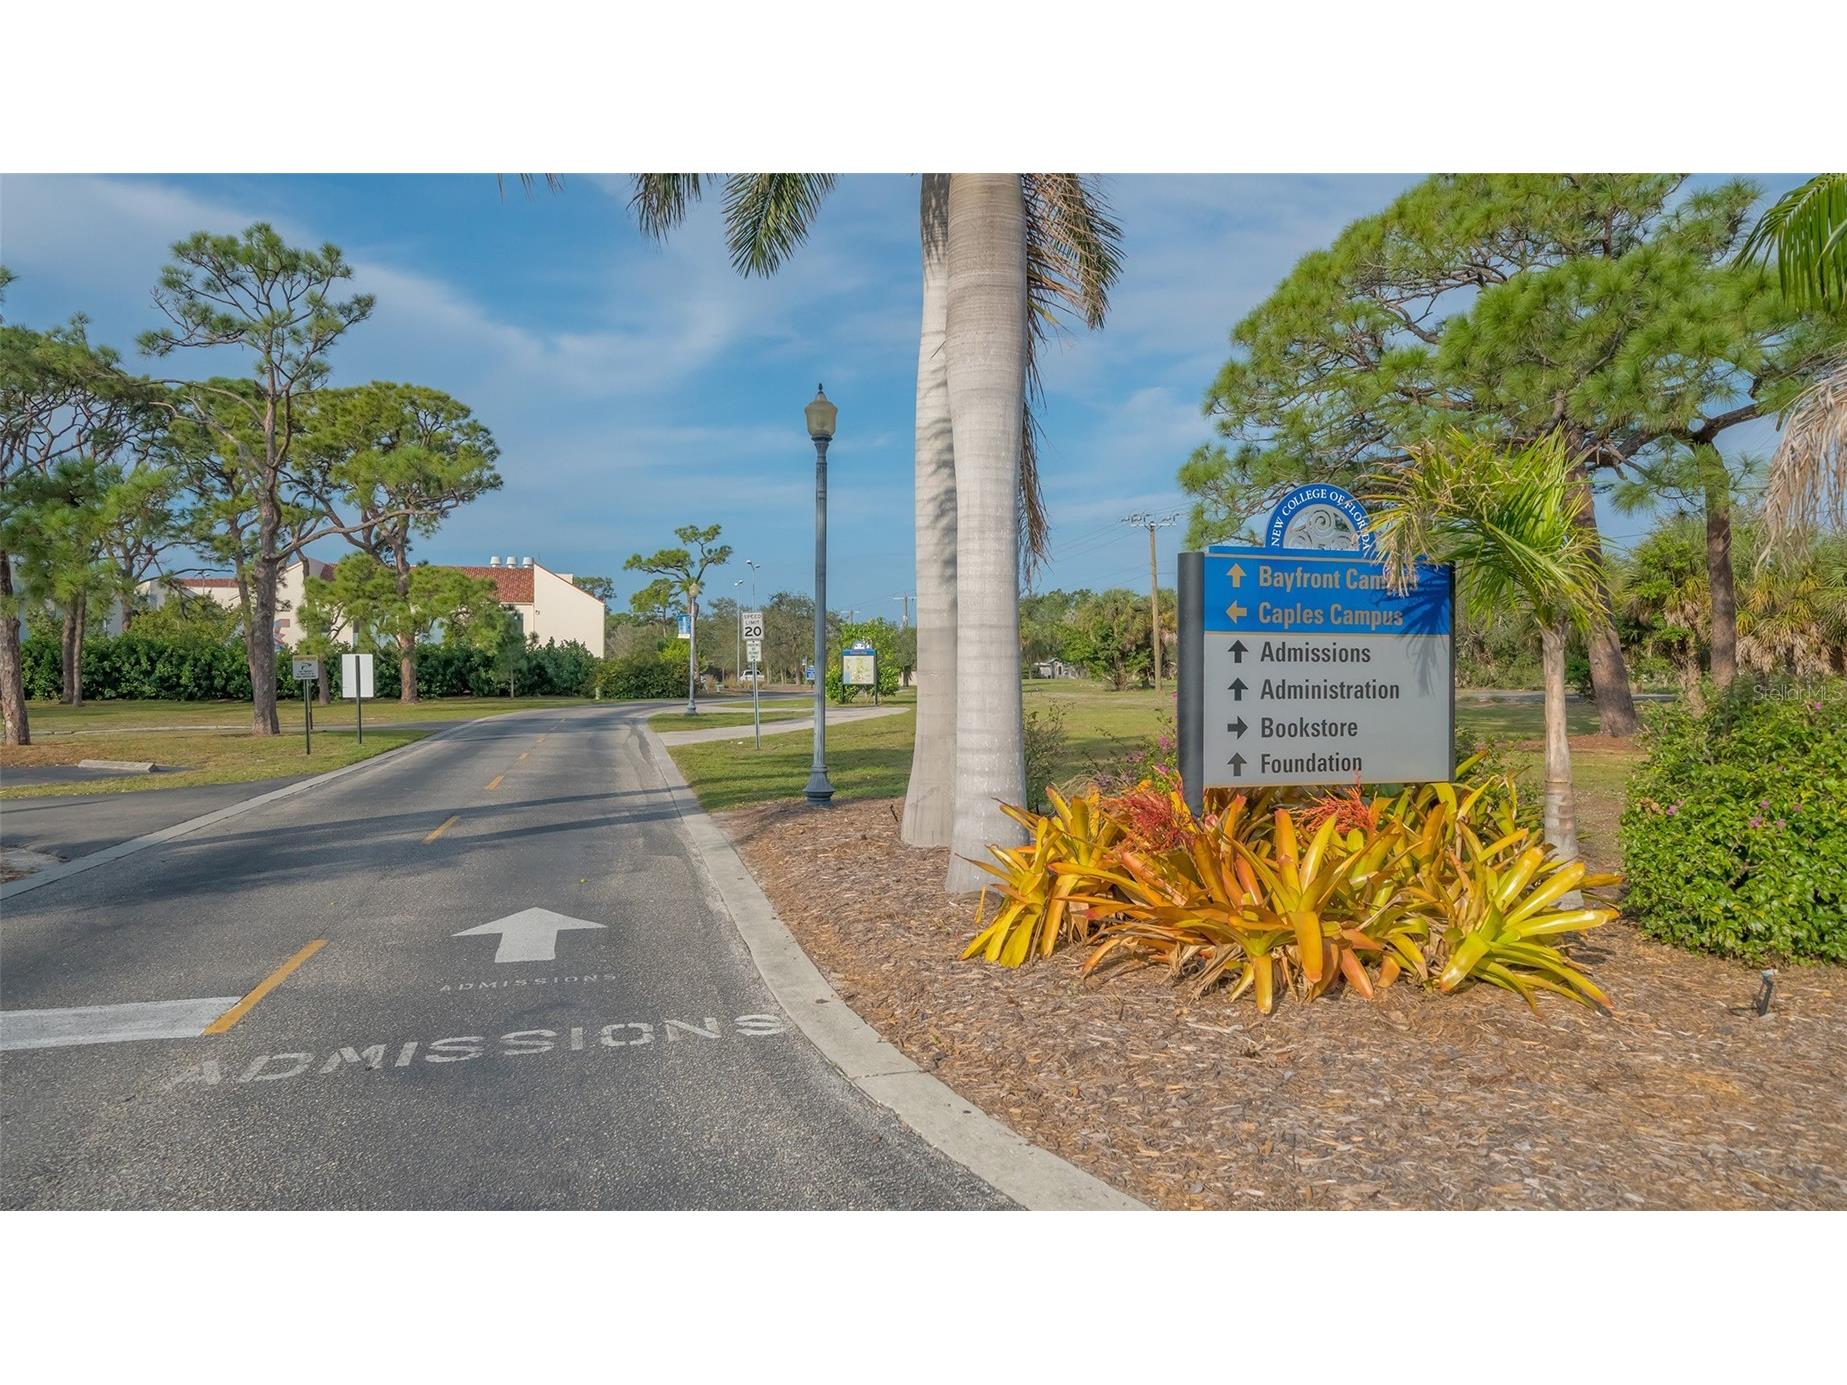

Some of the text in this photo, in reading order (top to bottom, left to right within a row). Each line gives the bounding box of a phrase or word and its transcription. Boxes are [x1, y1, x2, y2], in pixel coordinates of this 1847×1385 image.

[1271, 488, 1370, 550] NEW COLLEGE OF FLORDA
[1259, 565, 1340, 592] Bayfront
[1258, 602, 1403, 631] Caples Campus
[745, 626, 762, 637] 20
[1260, 641, 1371, 662] Admissions
[1260, 679, 1399, 699] Administration
[1261, 717, 1358, 738] Bookstore
[1261, 752, 1362, 773] Foundation
[439, 974, 617, 992] ADMISSIONS
[171, 1014, 785, 1086] ADMISSIONS
